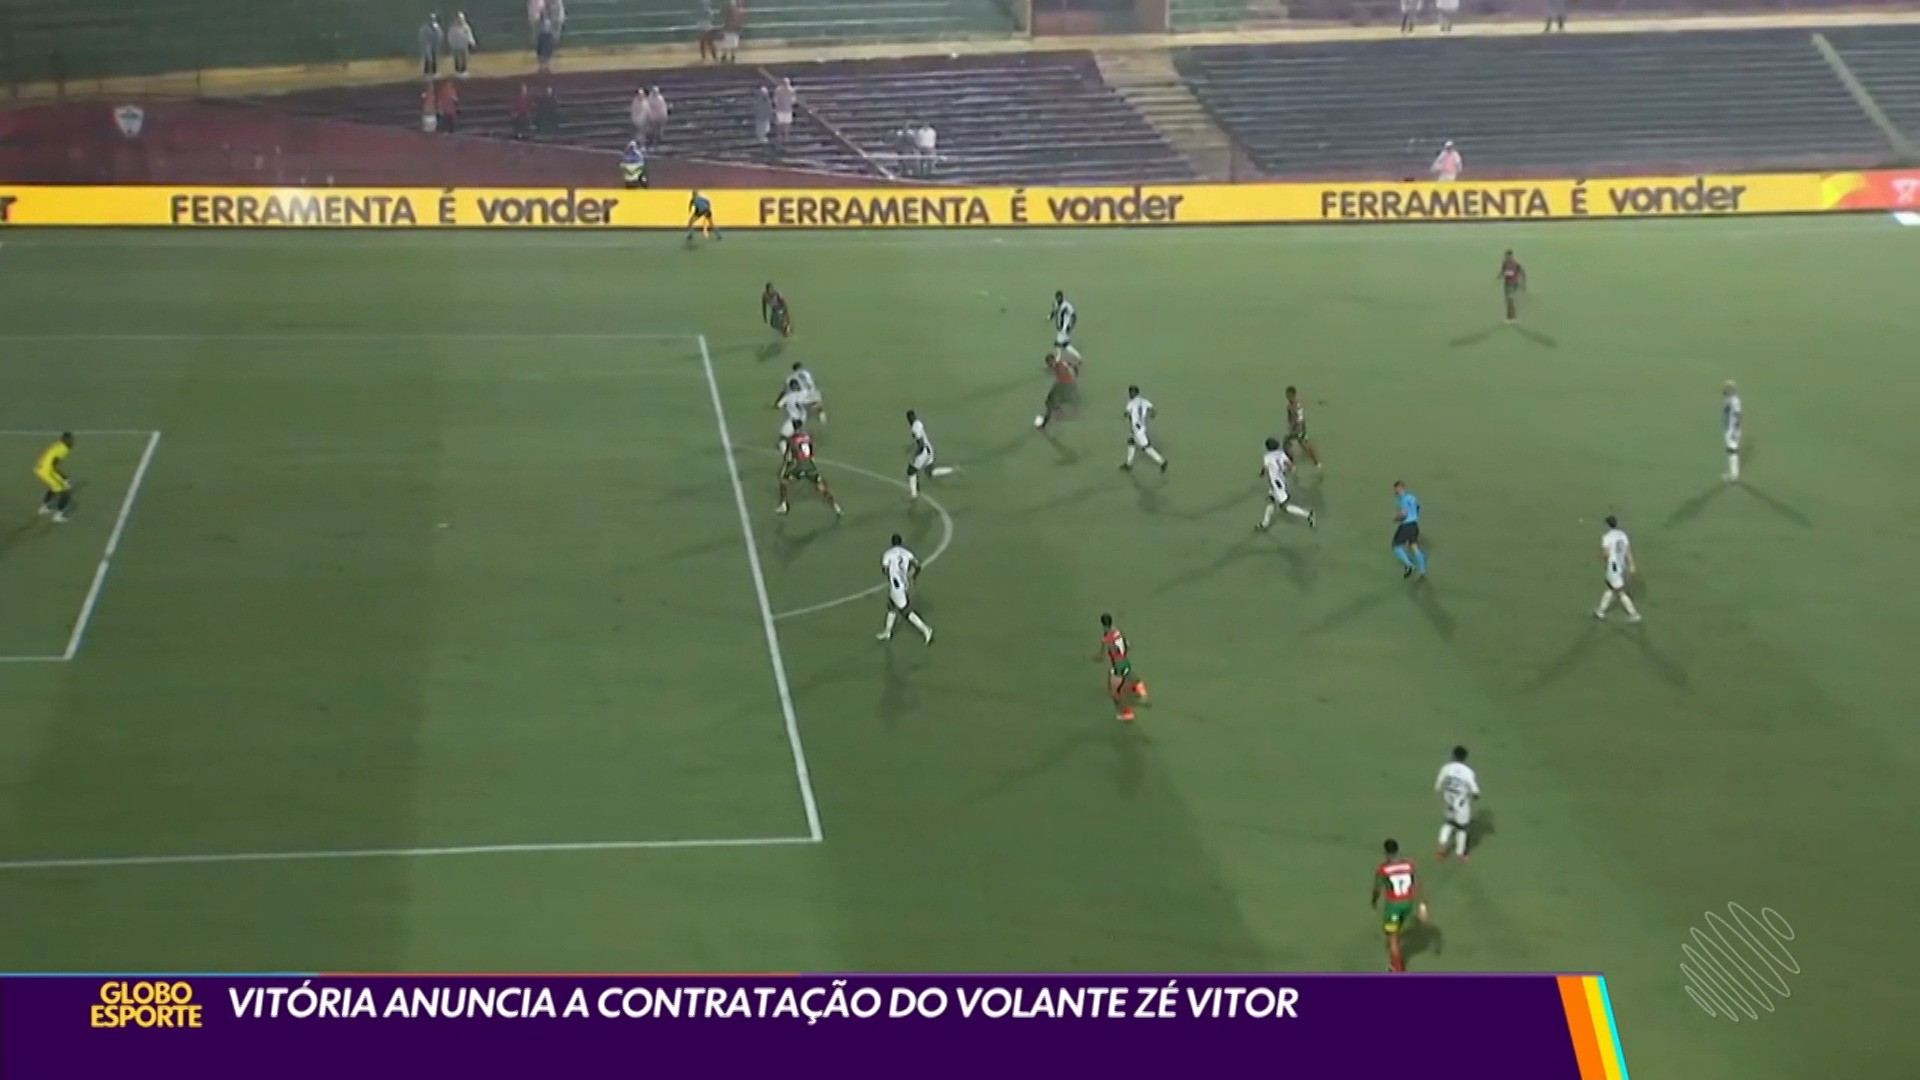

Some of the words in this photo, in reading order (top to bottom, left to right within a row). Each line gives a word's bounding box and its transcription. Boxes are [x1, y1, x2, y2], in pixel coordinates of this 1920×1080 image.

[169, 195, 416, 224] FERRAMENTA
[438, 188, 456, 224] É
[477, 186, 619, 224] vonder
[758, 196, 990, 225] FERRAMENTA
[1010, 189, 1028, 223] É
[1047, 184, 1184, 221] vonder
[1320, 188, 1550, 218] FERRAMENTA
[1570, 181, 1588, 215] É
[1609, 179, 1747, 213] vonder
